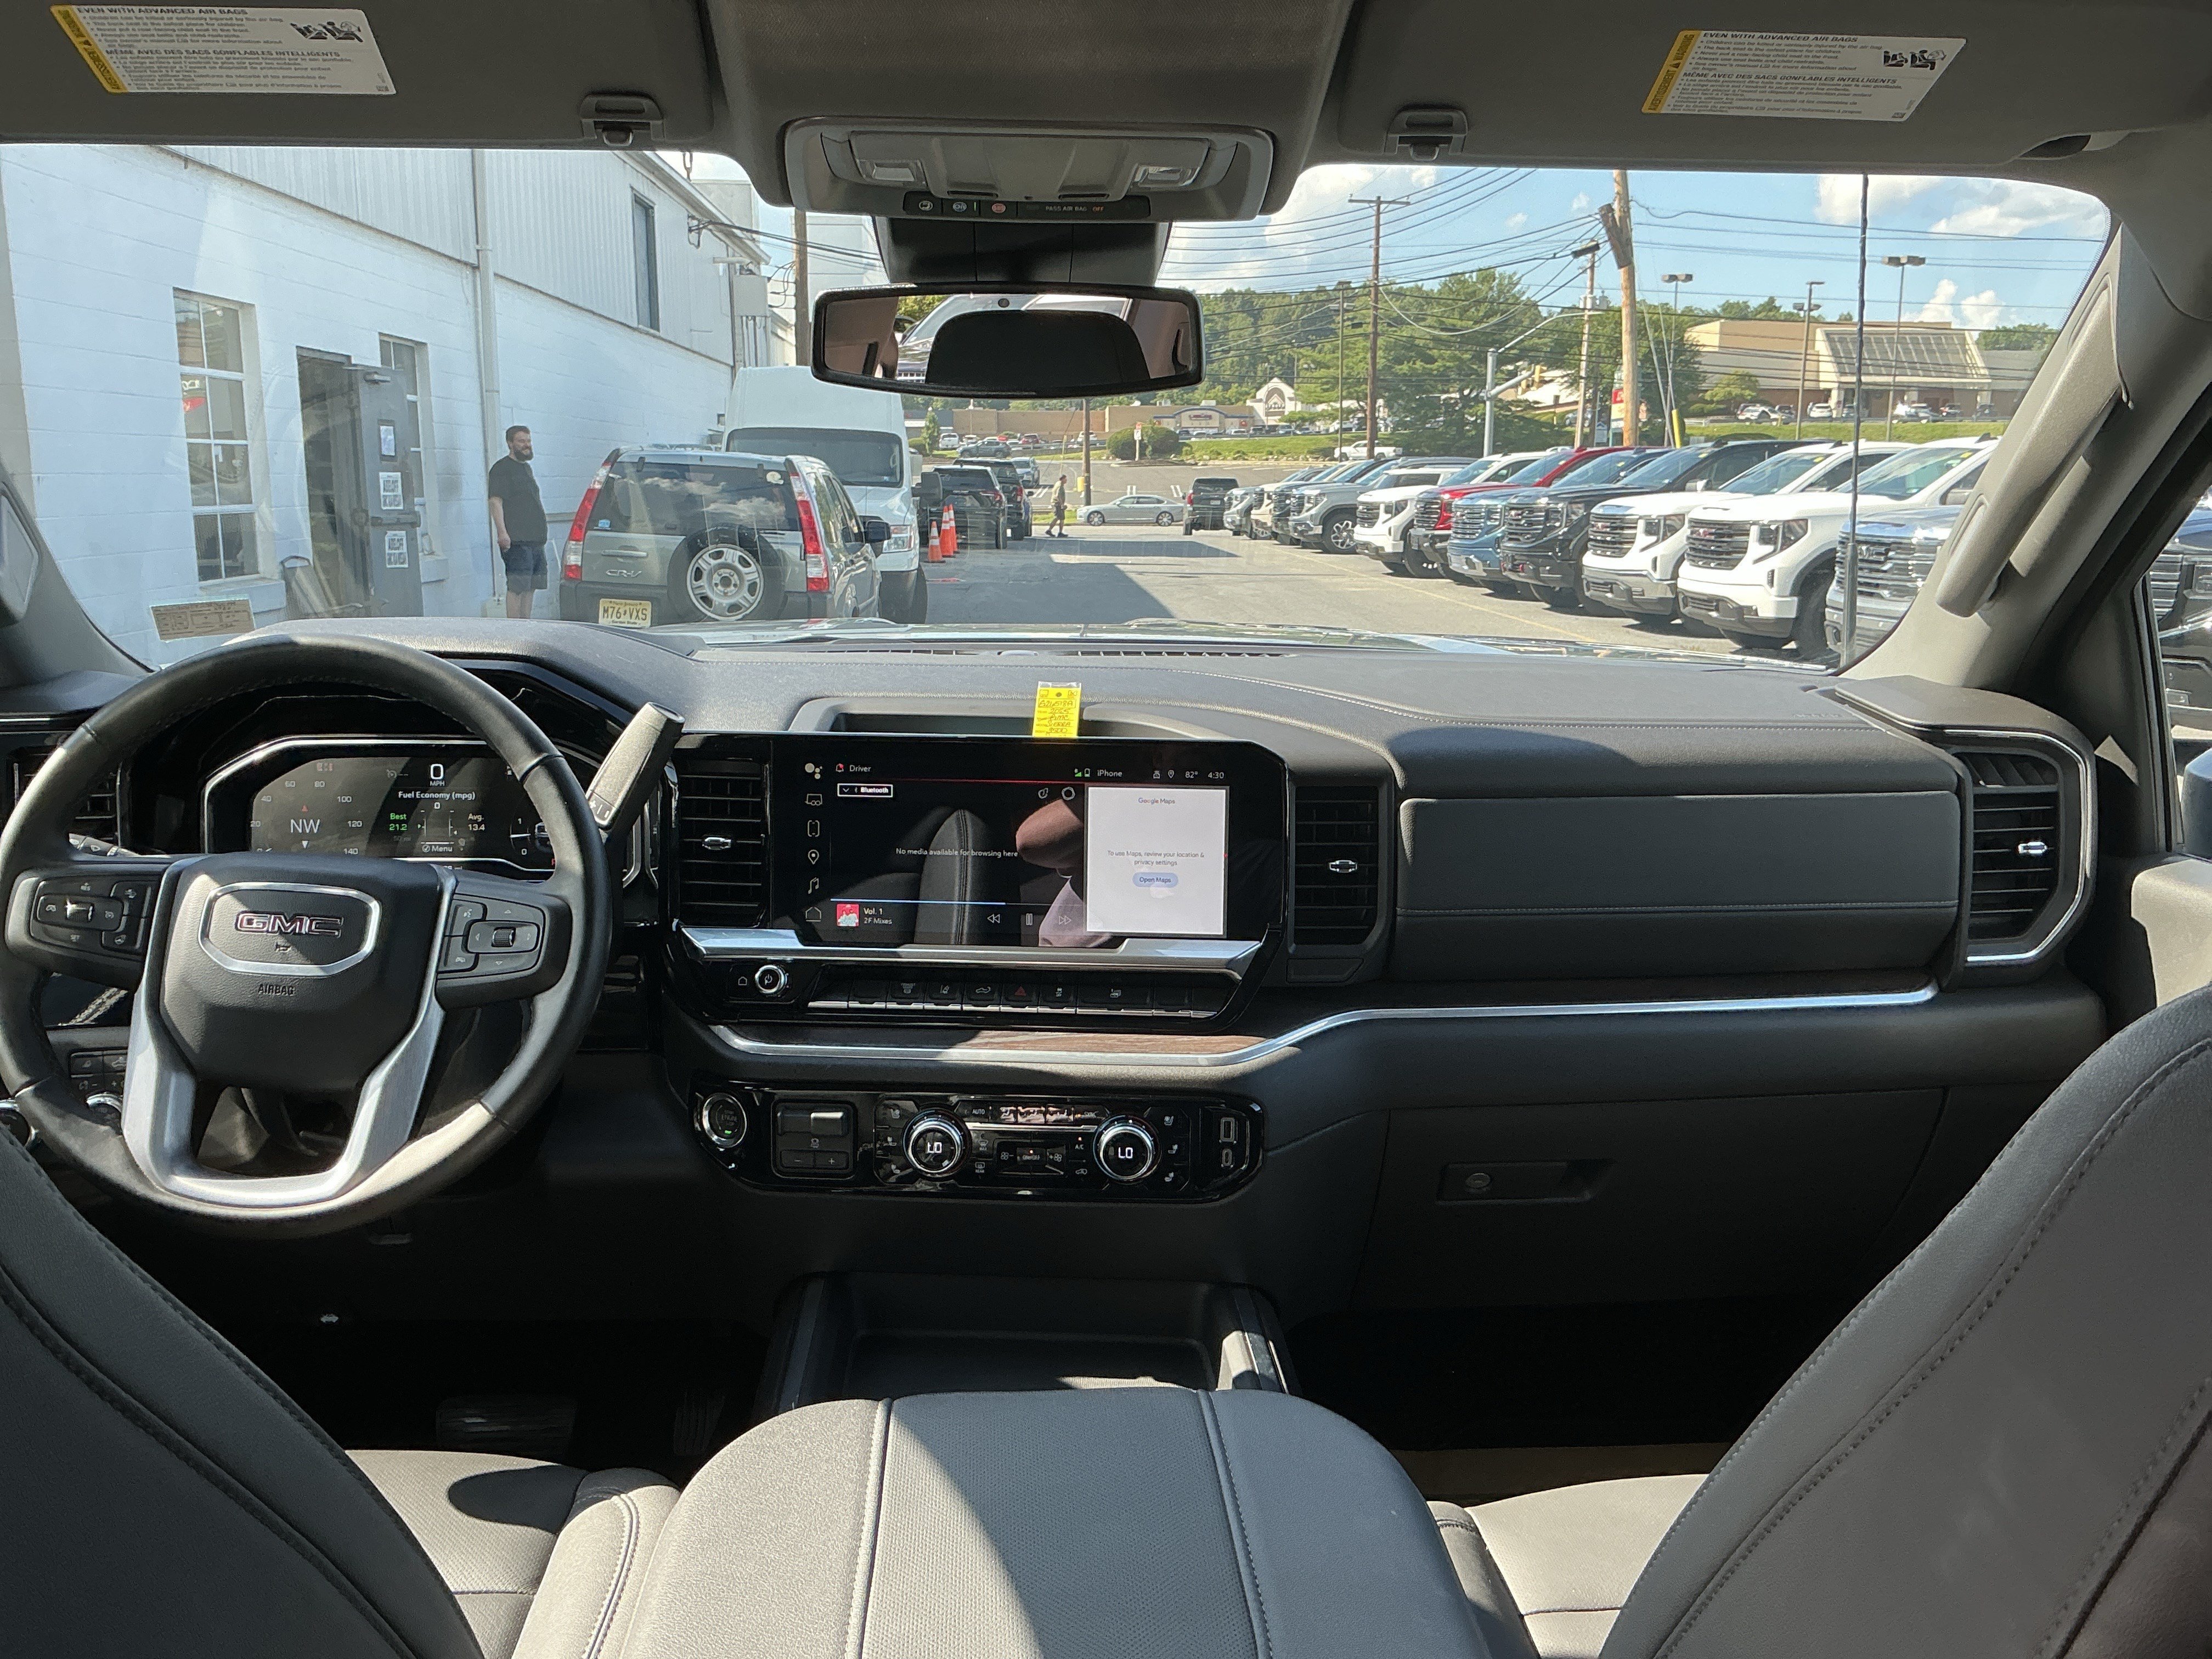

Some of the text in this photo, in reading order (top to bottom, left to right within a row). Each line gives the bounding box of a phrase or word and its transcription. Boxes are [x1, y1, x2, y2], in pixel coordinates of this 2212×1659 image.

[605, 569, 642, 578] CR-V
[431, 764, 444, 780] 0
[849, 764, 872, 772] Driver
[1097, 769, 1122, 777] iPhone
[1185, 771, 1198, 779] 82°
[416, 791, 451, 800] Economy
[452, 791, 476, 800] (mpg)
[468, 813, 485, 822] Avg.
[290, 819, 321, 834] NW
[971, 849, 1002, 858] browsing
[863, 907, 877, 915] Vol.
[235, 910, 343, 938] GMC
[258, 983, 296, 996] AIRBAG
[1118, 1147, 1134, 1159] LO
